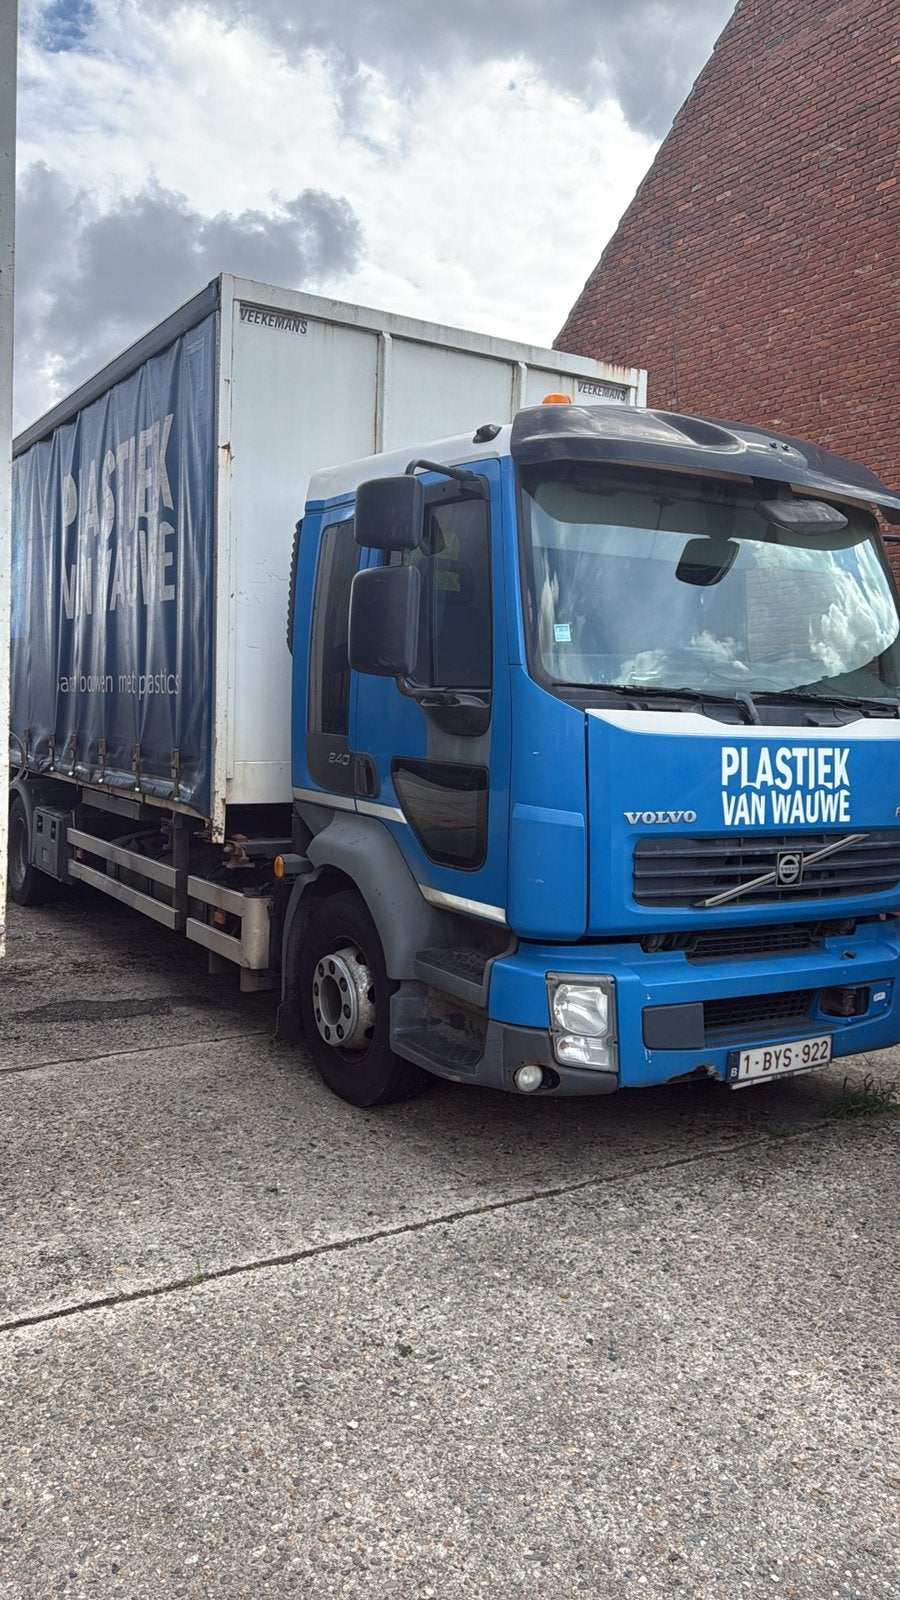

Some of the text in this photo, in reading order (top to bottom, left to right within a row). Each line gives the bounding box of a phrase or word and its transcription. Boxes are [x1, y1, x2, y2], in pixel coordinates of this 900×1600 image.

[239, 307, 307, 335] VEEKEMANS
[577, 381, 626, 402] VEEKEMANS
[62, 556, 92, 619] VN
[118, 671, 136, 694] met
[138, 668, 180, 701] pastics
[328, 752, 350, 766] 240
[721, 746, 851, 790] PLASTIEK
[623, 810, 697, 825] VOLVO
[722, 788, 851, 826] VAN WAUWE
[730, 1067, 738, 1077] B
[744, 1040, 829, 1074] 1-BYS-922
